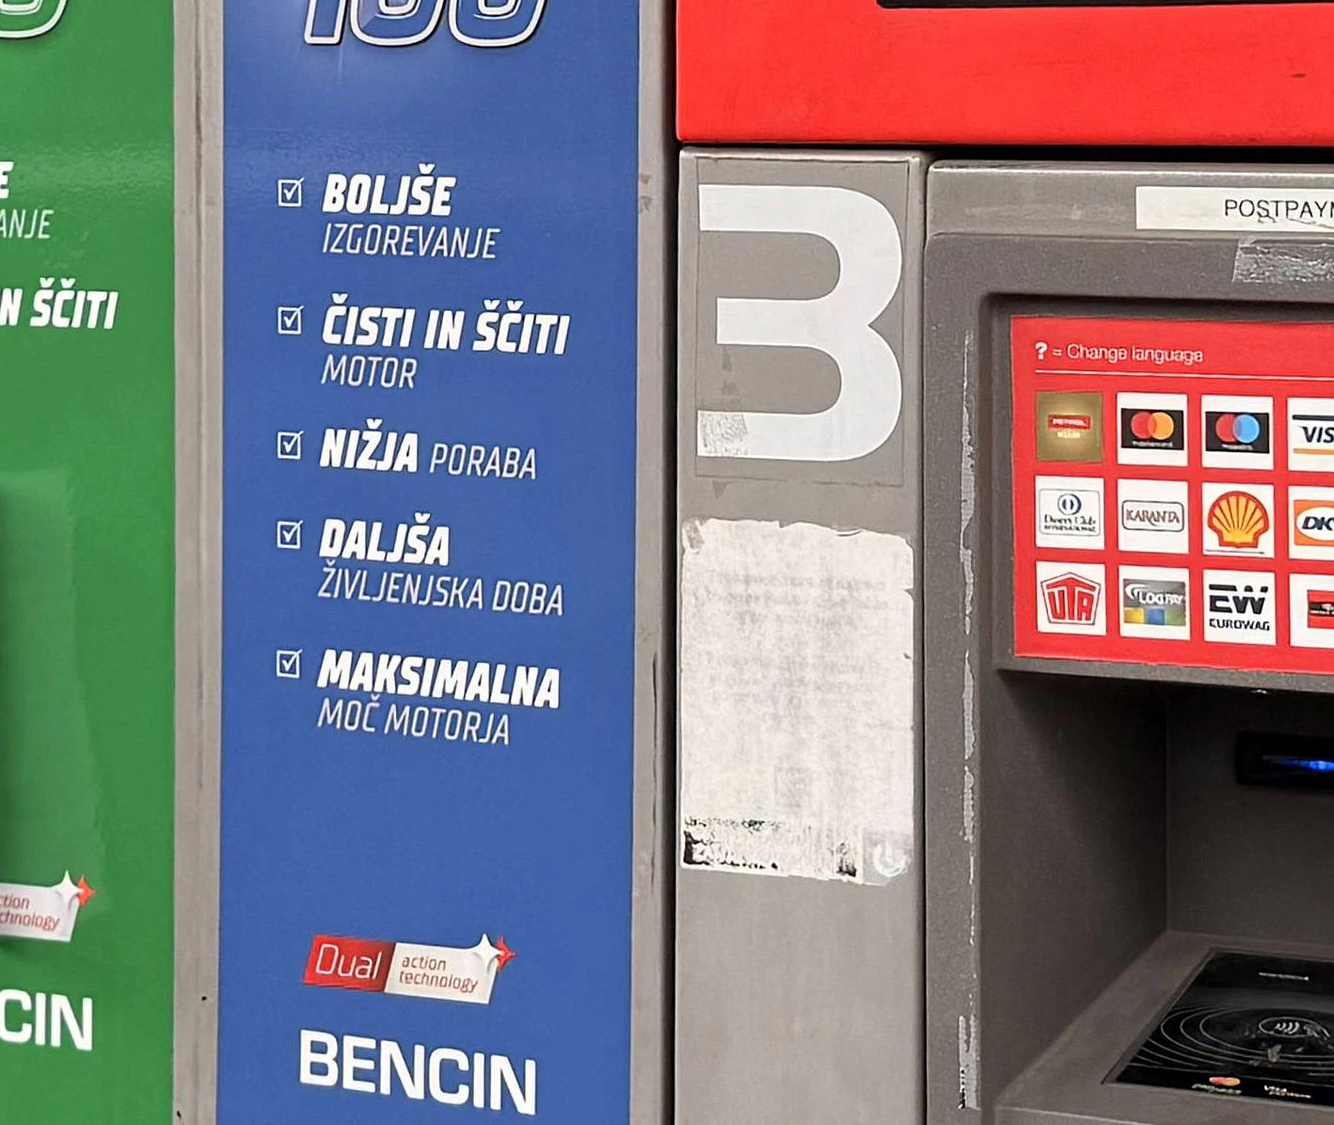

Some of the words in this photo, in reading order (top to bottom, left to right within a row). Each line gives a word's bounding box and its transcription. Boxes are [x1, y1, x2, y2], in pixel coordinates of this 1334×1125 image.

[321, 163, 457, 217] BOLJŠE
[322, 223, 501, 259] IZGOREVANJE
[29, 277, 119, 329] ŠČITI
[321, 293, 416, 348] ČISTI
[424, 309, 465, 350] IN
[472, 300, 570, 355] ŠČITI
[697, 184, 902, 462] 3
[320, 355, 417, 389] MOTOR
[1067, 344, 1128, 362] Change
[1131, 346, 1203, 365] language
[319, 418, 418, 473] NIŽJA
[429, 443, 537, 480] PORABA
[319, 512, 450, 566] DALJŠA
[1126, 509, 1179, 526] KARANTA
[317, 560, 484, 610] ŽIVLJENJSKA
[492, 580, 563, 616] DOBA
[1047, 577, 1096, 621] UTA
[1209, 618, 1270, 631] EUROWAG
[317, 649, 561, 709] MAKSIMALNA
[317, 693, 380, 732] MOČ
[384, 704, 510, 745] MOTORJA
[315, 943, 382, 980] Dual
[399, 970, 479, 994] technology
[401, 955, 447, 972] action
[300, 1029, 536, 1116] BENCIN
